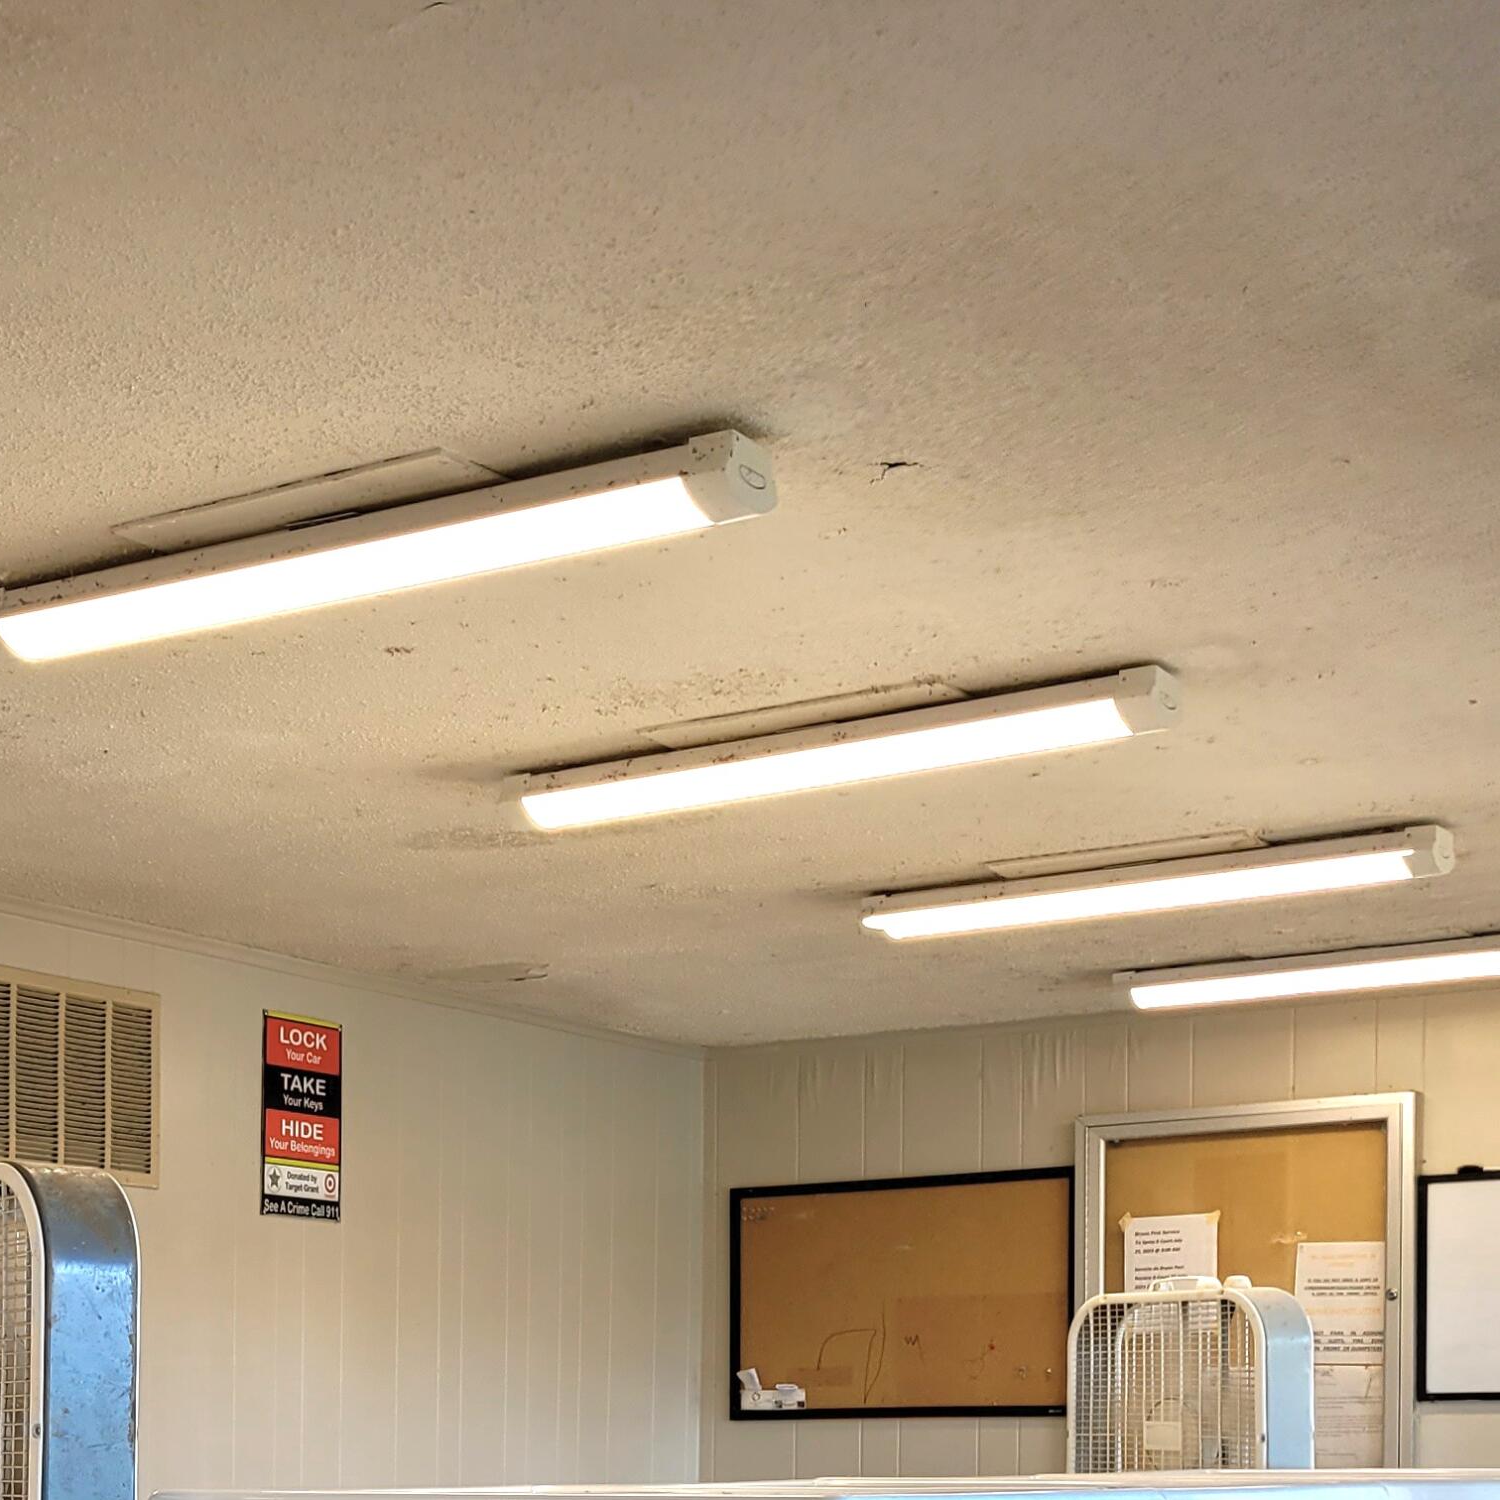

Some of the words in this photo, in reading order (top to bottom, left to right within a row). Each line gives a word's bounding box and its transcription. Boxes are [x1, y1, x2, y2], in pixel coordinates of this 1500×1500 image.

[280, 1026, 327, 1051] LOCK
[286, 1048, 305, 1062] Your
[306, 1052, 322, 1065] Car
[280, 1073, 327, 1096] TAKE
[283, 1094, 302, 1107] Your
[303, 1097, 324, 1112] Keys
[281, 1118, 324, 1141] HIDE
[269, 1136, 289, 1150] Your
[290, 1140, 336, 1158] Belongings
[286, 1171, 310, 1182] Donated
[285, 1182, 303, 1193] Target
[303, 1185, 319, 1194] Grant
[264, 1199, 279, 1213] See
[280, 1200, 287, 1213] A
[287, 1201, 310, 1216] Crime
[311, 1204, 325, 1217] Call
[326, 1206, 340, 1219] 911
